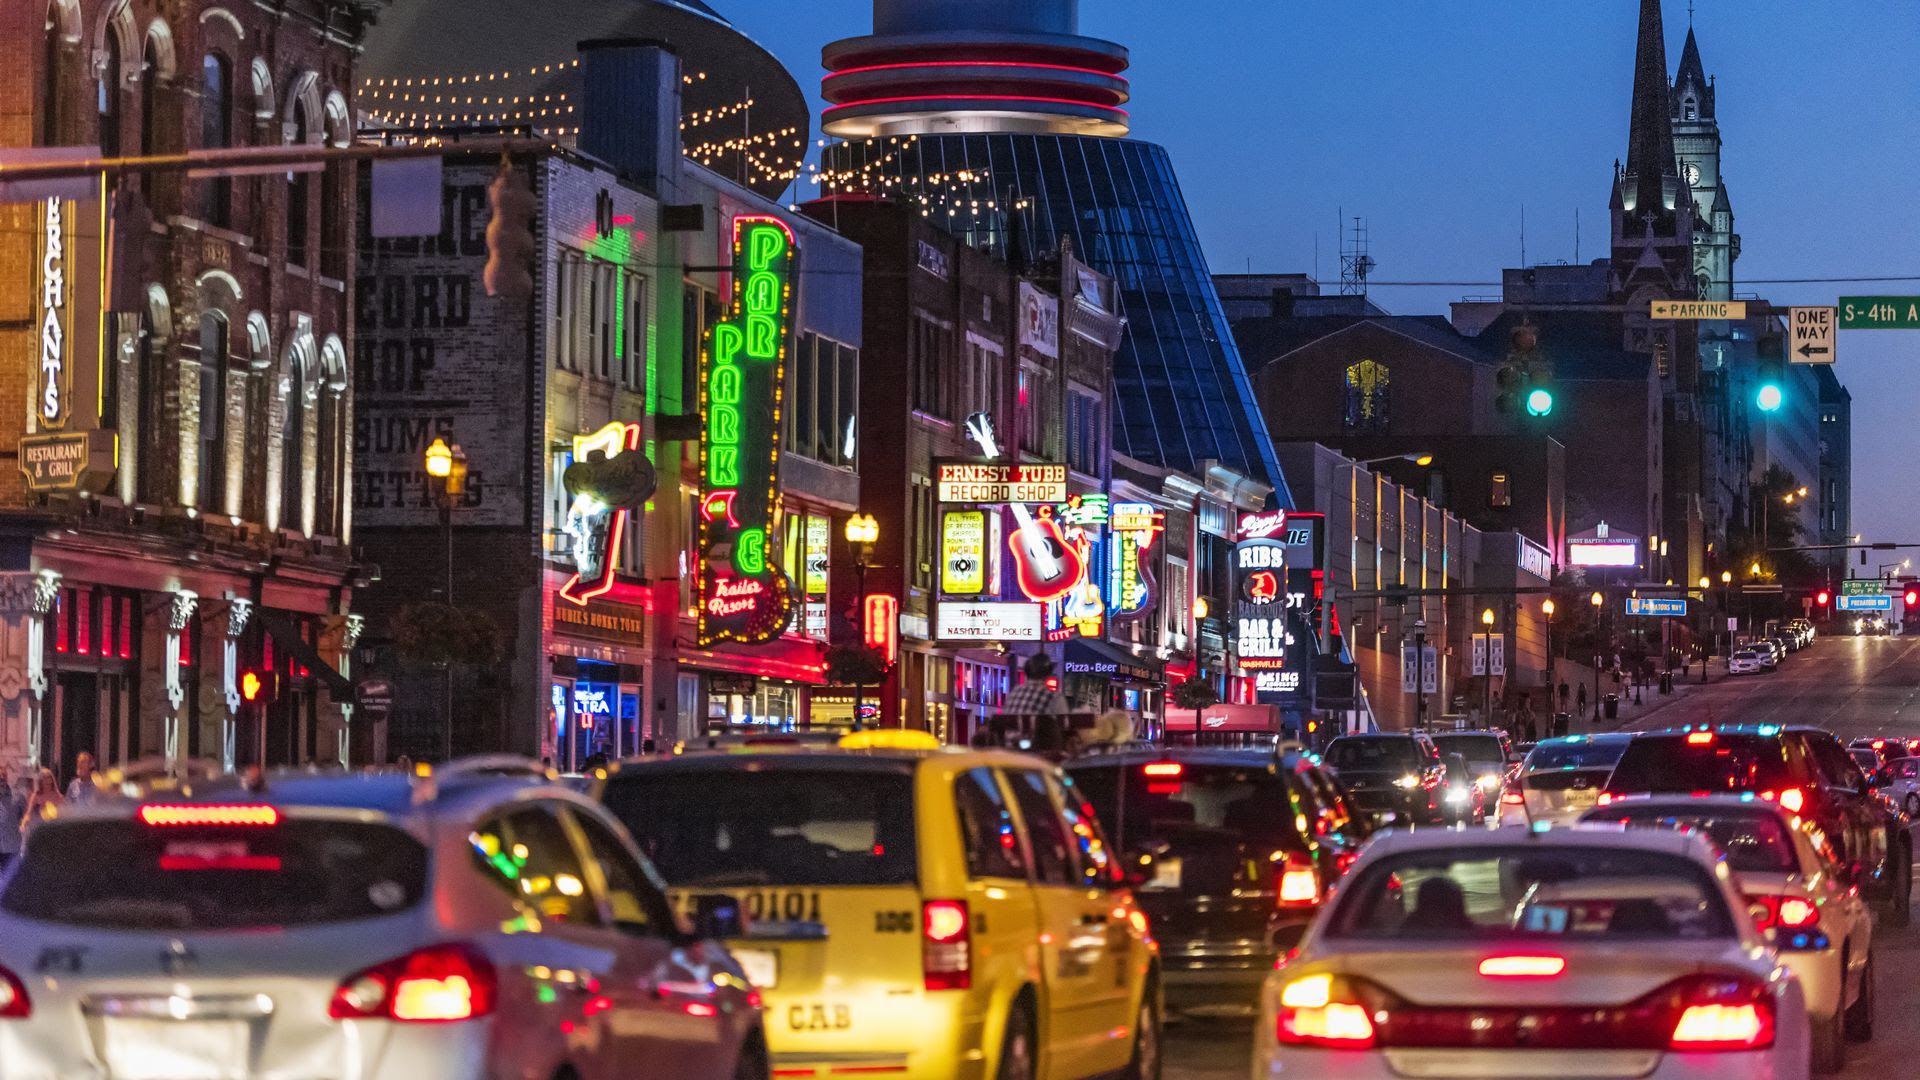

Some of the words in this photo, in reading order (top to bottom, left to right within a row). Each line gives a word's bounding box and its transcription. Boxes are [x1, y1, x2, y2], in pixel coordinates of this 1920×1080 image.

[1670, 303, 1728, 318] PARKING
[1797, 312, 1828, 324] ONE
[1844, 306, 1897, 321] S-4th
[1796, 326, 1829, 340] WAY
[709, 325, 743, 485] PARK
[27, 444, 83, 463] RESTAURANT
[35, 462, 43, 478] &
[48, 461, 74, 477] GRILL
[941, 466, 1011, 482] ERNEST
[1018, 466, 1066, 482] TUBB
[950, 485, 1010, 500] RECORD
[1017, 485, 1057, 500] SHOP
[962, 514, 981, 522] TYPES
[1113, 517, 1152, 527] MELLOW
[956, 522, 982, 530] RECORDS
[948, 544, 979, 555] WORLD
[1238, 547, 1284, 569] RIBS
[1123, 531, 1137, 609] MUSHROOM
[714, 579, 763, 598] Trailer
[708, 597, 756, 617] Resort
[947, 627, 993, 636] NASHVILLE
[1002, 628, 1033, 636] POLICE
[1238, 618, 1270, 638] BAR
[1271, 618, 1284, 638] &
[1237, 638, 1284, 656] GRILL
[1065, 662, 1089, 673] Pizza
[1094, 662, 1118, 673] Beer
[1239, 660, 1283, 669] NASHVILLE
[787, 1003, 851, 1032] CAB
